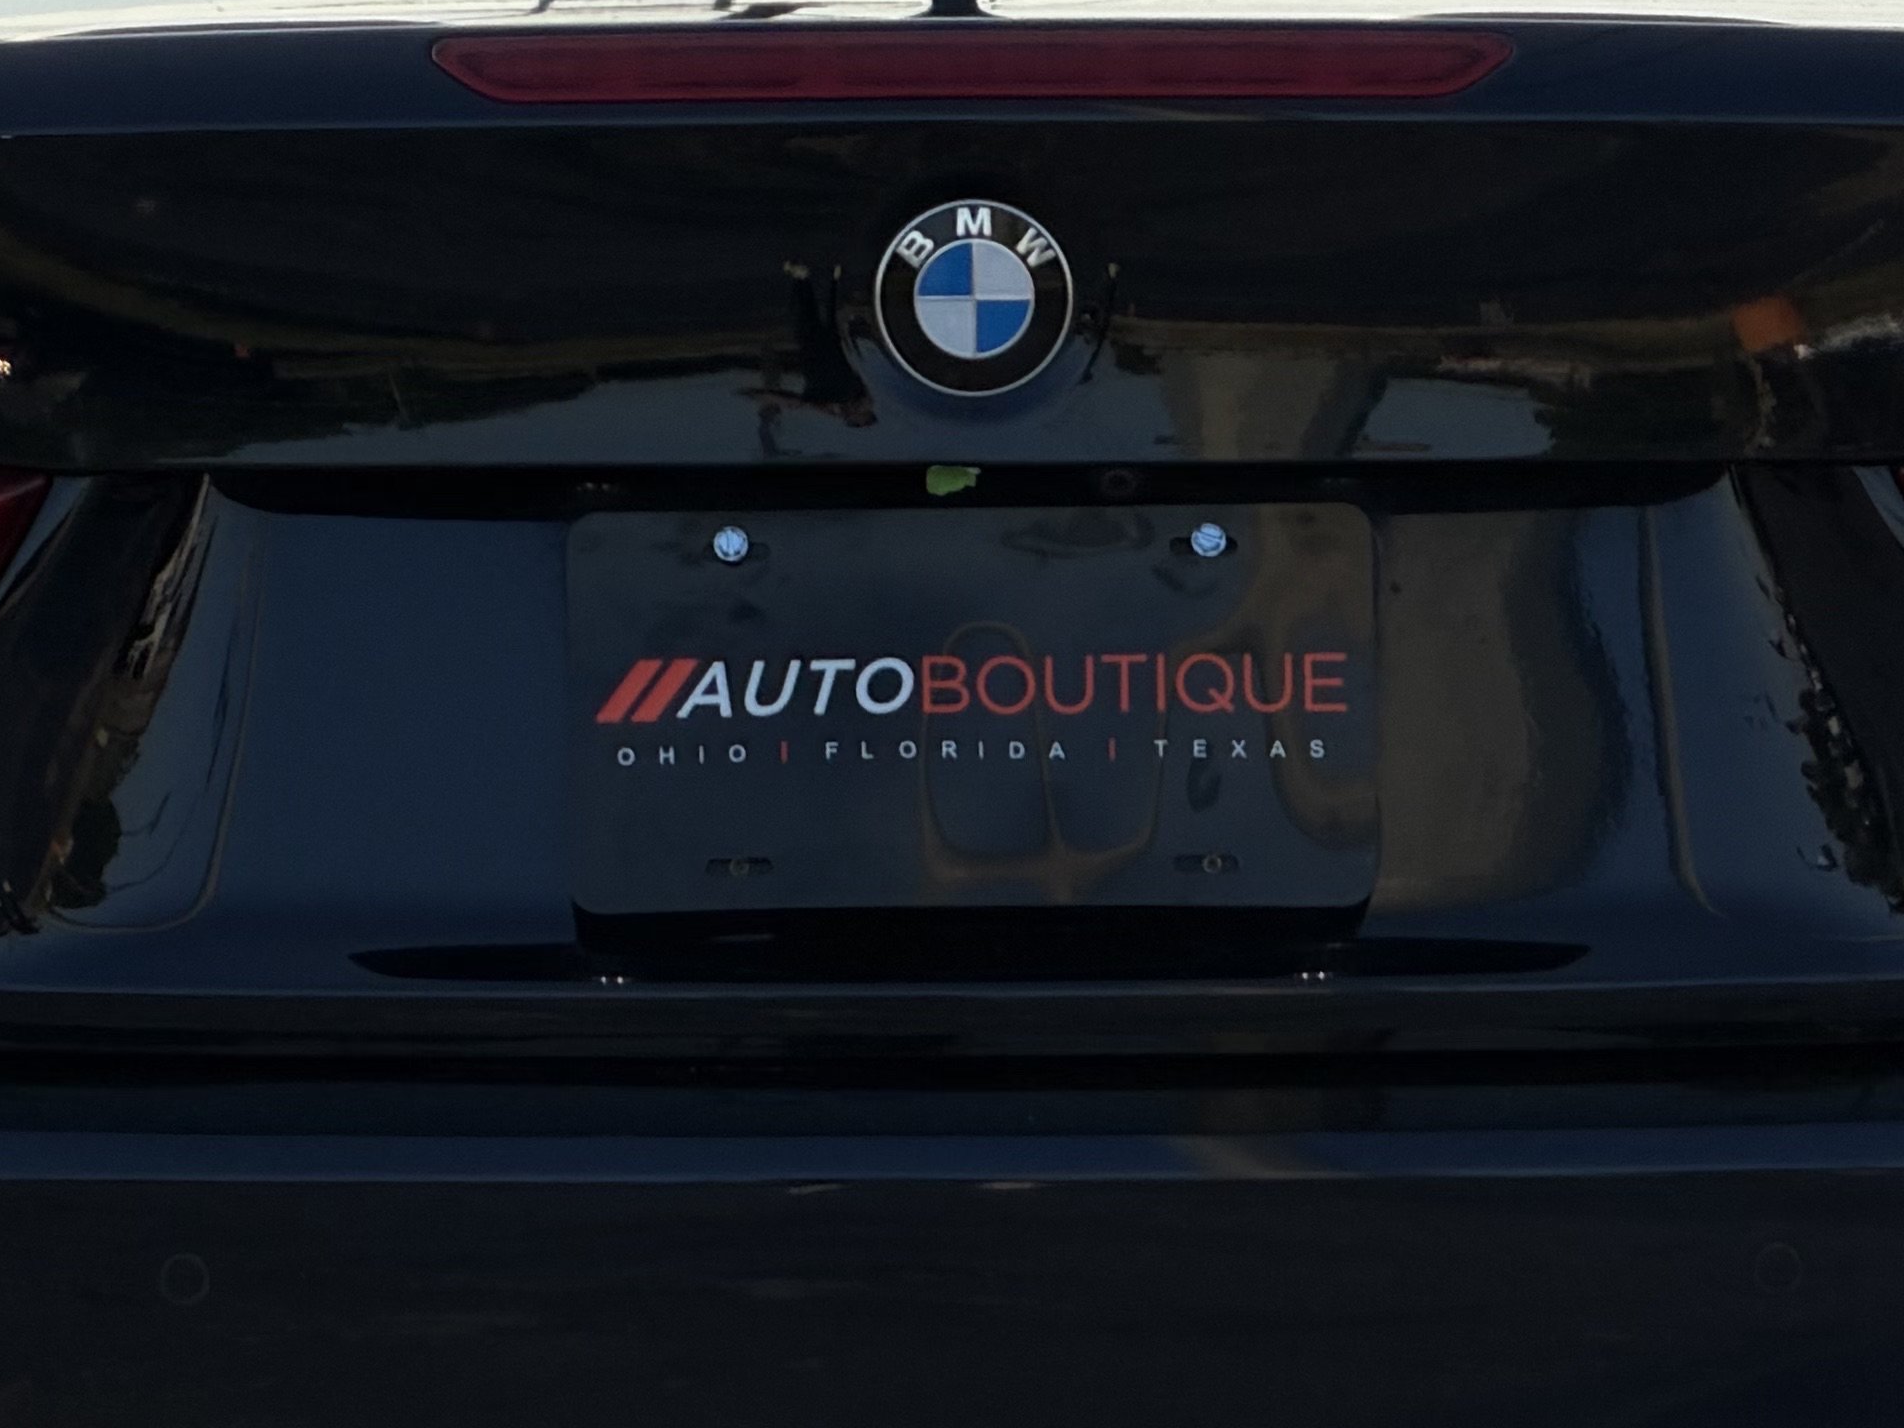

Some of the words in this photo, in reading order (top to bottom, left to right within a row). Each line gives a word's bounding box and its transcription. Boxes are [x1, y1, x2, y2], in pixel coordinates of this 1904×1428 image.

[897, 206, 1056, 269] BMW
[616, 744, 748, 766] OHIO
[824, 739, 1066, 762] FLORIDA
[1154, 737, 1327, 759] TEXAS
